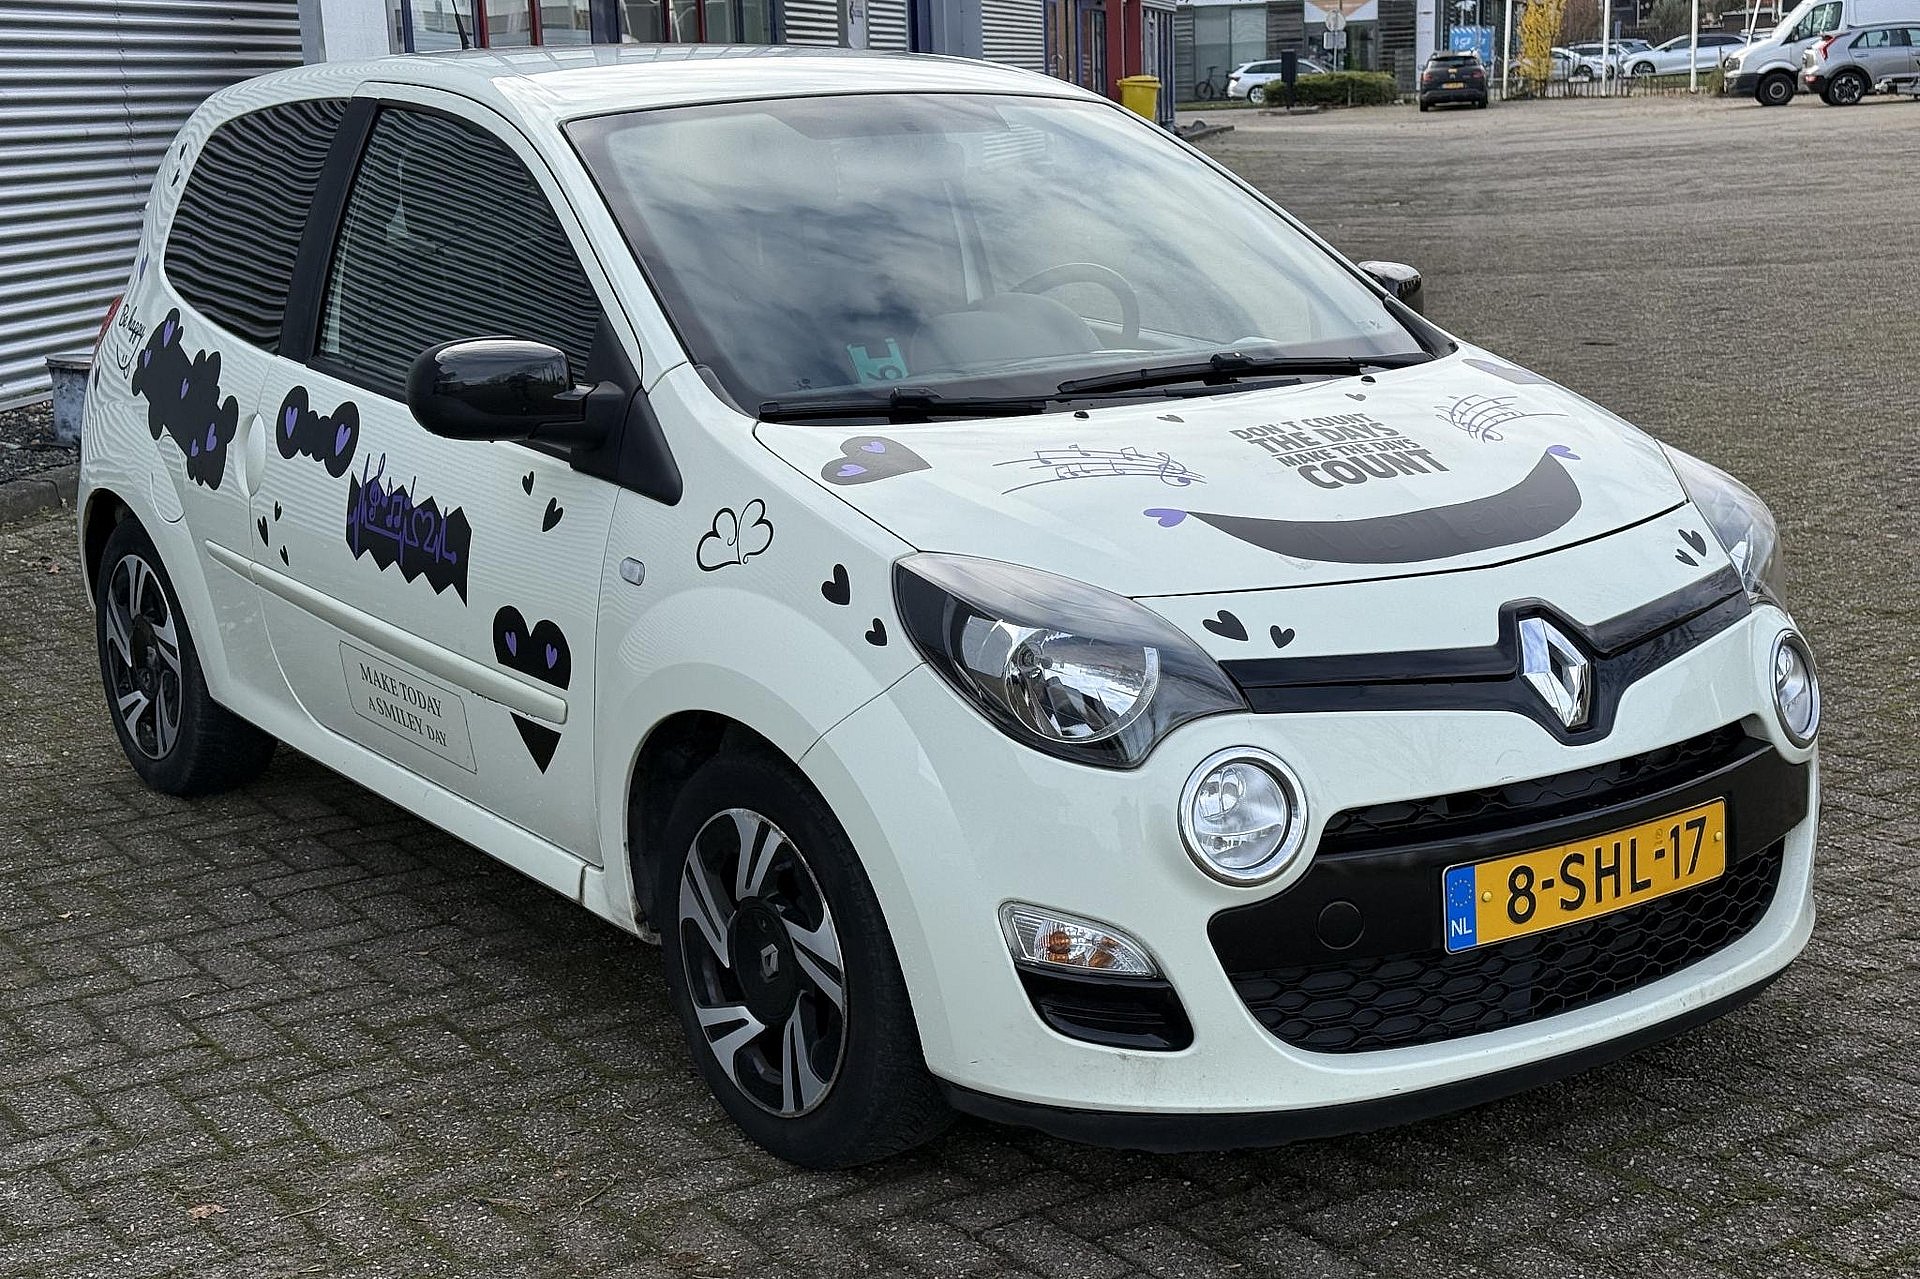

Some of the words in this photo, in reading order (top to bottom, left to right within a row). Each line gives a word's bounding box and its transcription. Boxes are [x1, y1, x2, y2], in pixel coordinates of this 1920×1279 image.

[1247, 432, 1321, 453] THE
[1319, 422, 1401, 443] DAYS
[1301, 413, 1373, 428] COUNT
[1276, 448, 1334, 467] MAKE
[1331, 443, 1371, 456] THE
[1373, 438, 1421, 453] DAYS
[1297, 448, 1450, 489] COUNT
[359, 662, 399, 697] MAKE
[399, 682, 442, 718] TODAY
[368, 697, 377, 712] A
[376, 697, 424, 735] SMILEY
[426, 725, 447, 747] DAY
[1507, 816, 1707, 925] 8-SHL-17
[1450, 917, 1473, 938] NL
